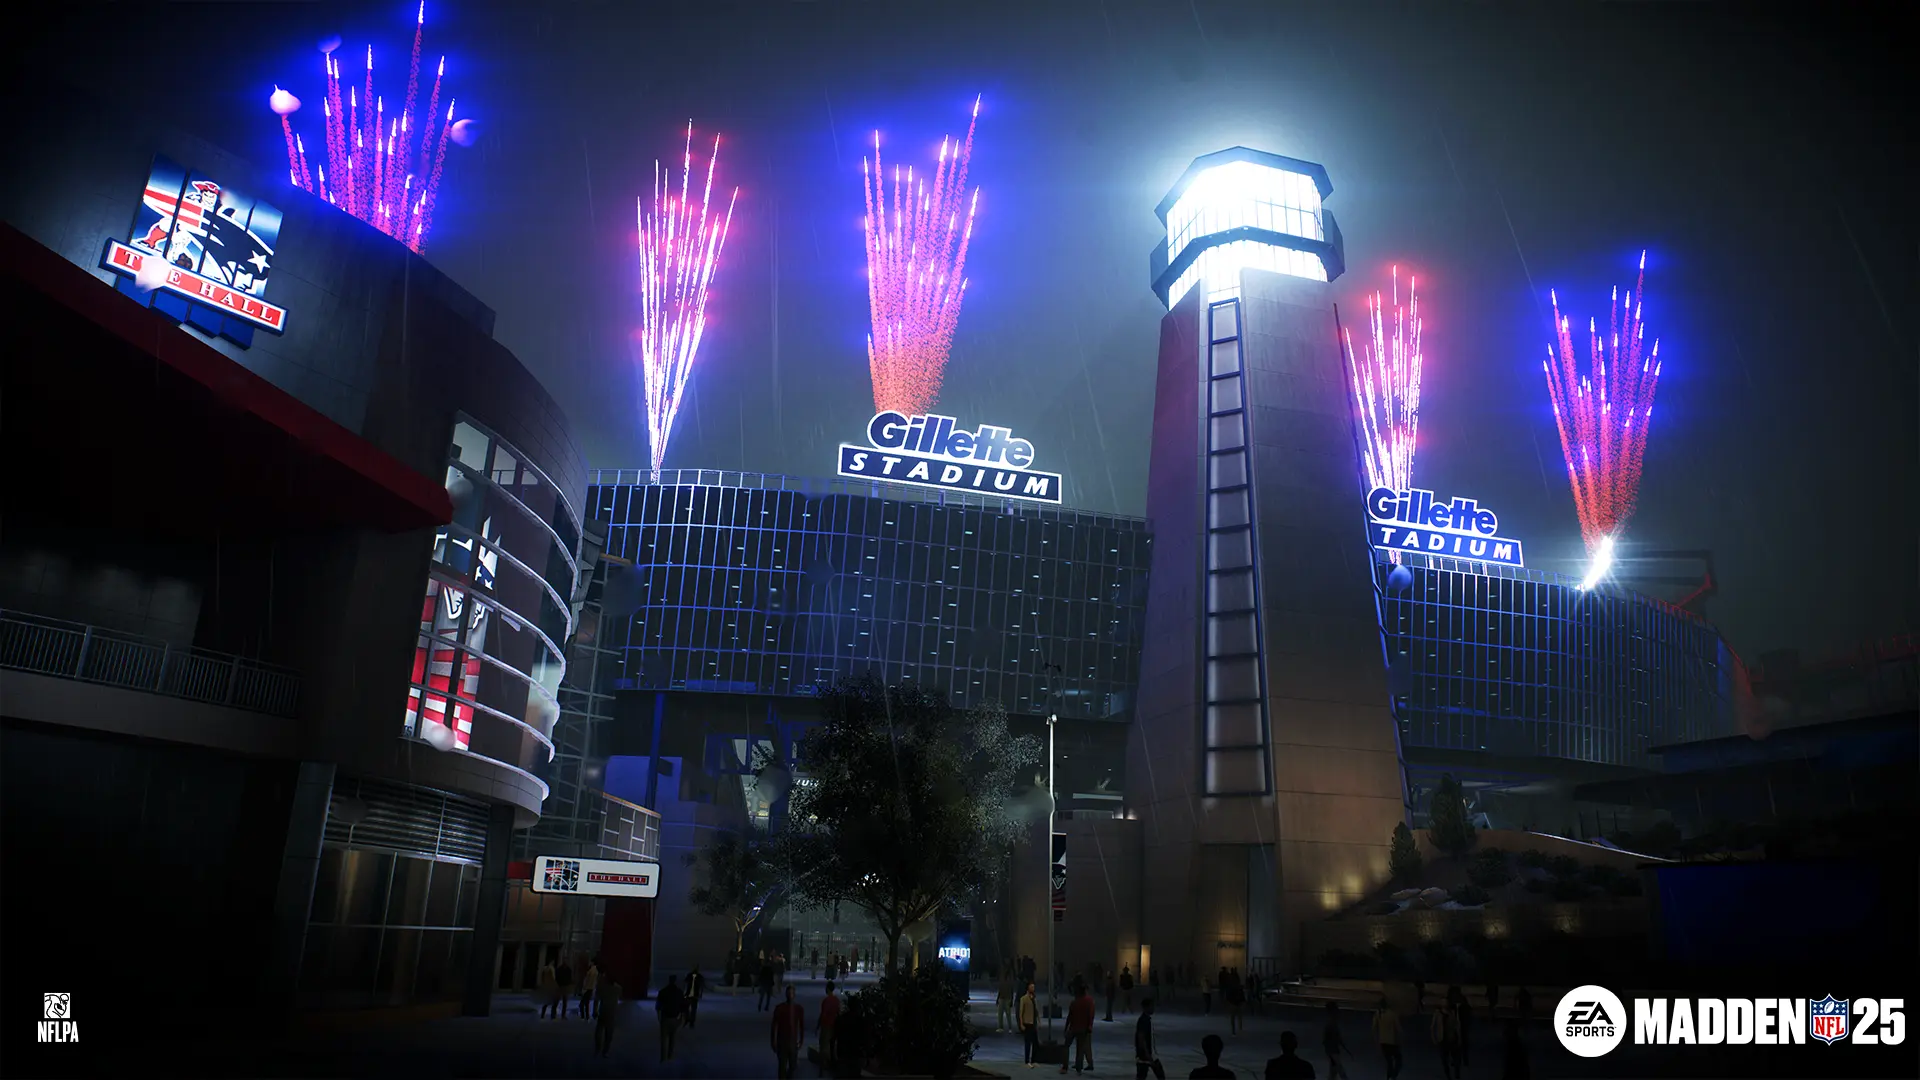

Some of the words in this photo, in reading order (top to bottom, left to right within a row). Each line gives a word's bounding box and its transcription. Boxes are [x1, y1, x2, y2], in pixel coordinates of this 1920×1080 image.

[124, 250, 182, 285] TE
[200, 281, 273, 321] HALL
[868, 411, 1034, 468] Gillette
[849, 452, 1050, 496] STADIUM
[1368, 487, 1497, 536] Gillette
